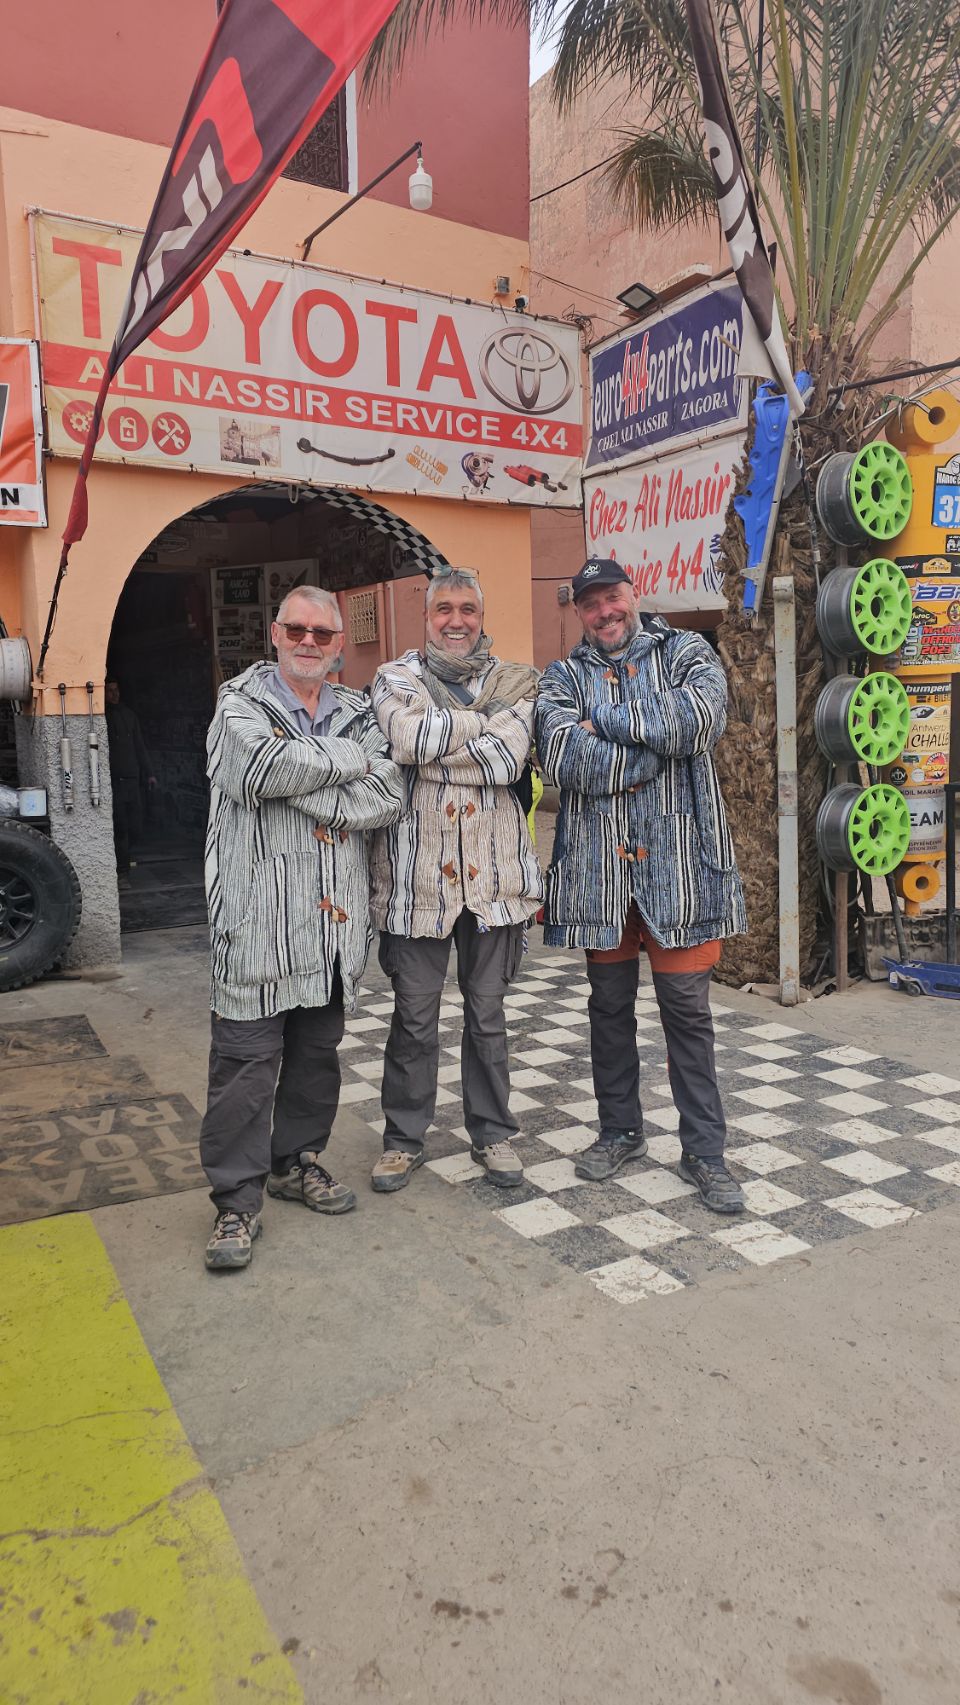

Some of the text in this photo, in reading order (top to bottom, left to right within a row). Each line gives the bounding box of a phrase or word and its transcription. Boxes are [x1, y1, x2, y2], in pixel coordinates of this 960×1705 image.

[52, 237, 477, 400] TOYOTA
[78, 356, 569, 451] ALI NASSIR SERVICE 4X4
[594, 318, 739, 432] euro4x4parts.com
[620, 425, 634, 445] ALI
[635, 411, 669, 439] NASSIR
[681, 390, 728, 421] ZAGORA
[589, 461, 731, 541] Chez Ali Nassir
[667, 537, 704, 594] 4x4
[916, 585, 960, 599] BB
[910, 810, 944, 827] EAM
